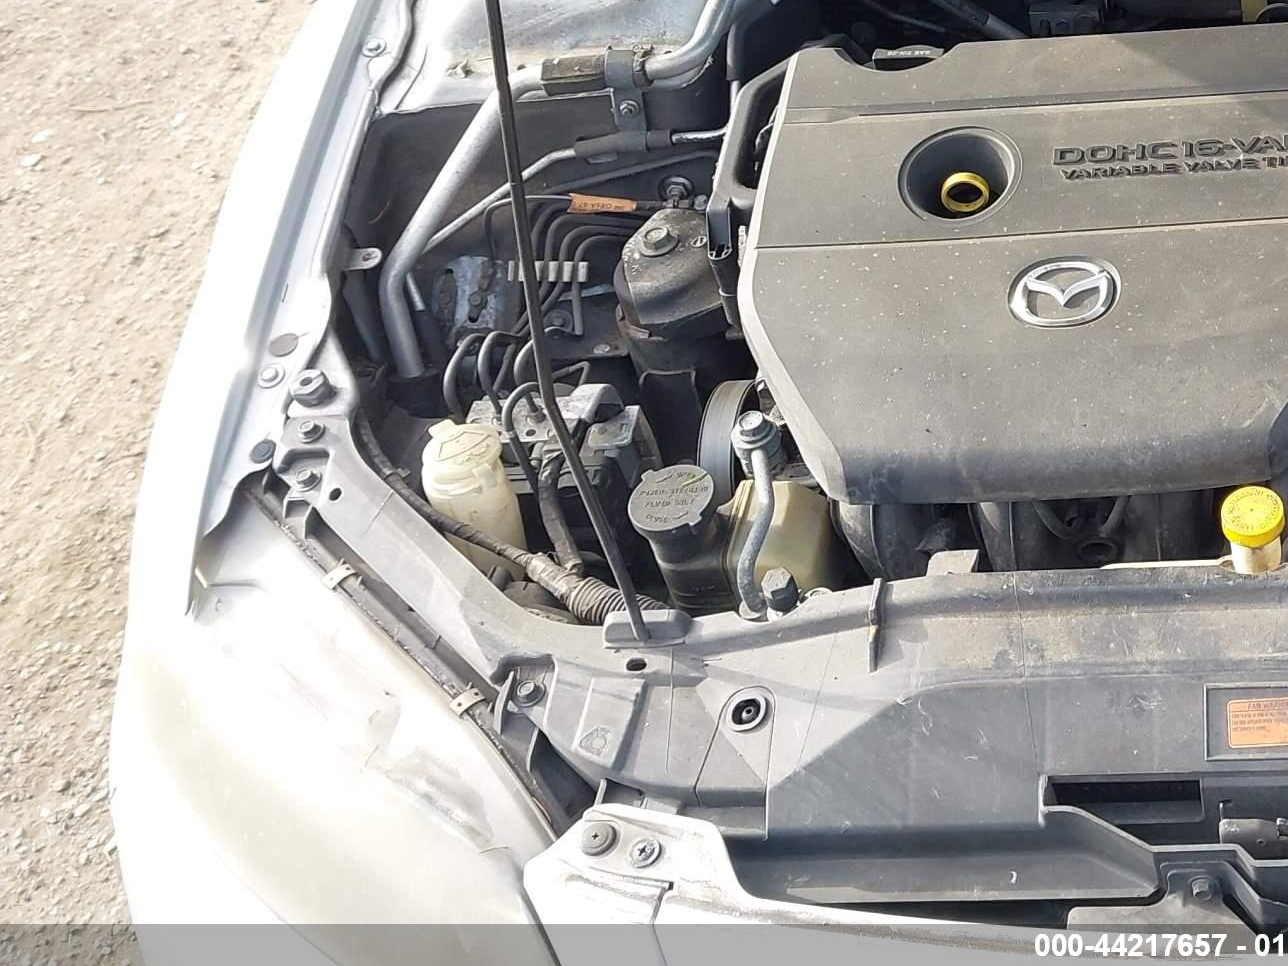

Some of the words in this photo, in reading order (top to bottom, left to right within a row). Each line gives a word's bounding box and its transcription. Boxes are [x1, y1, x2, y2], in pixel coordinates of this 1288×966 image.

[1052, 141, 1179, 166] DOHC
[1060, 162, 1182, 181] VARIABLE
[1183, 157, 1261, 173] VALVE
[1247, 701, 1263, 711] FAN
